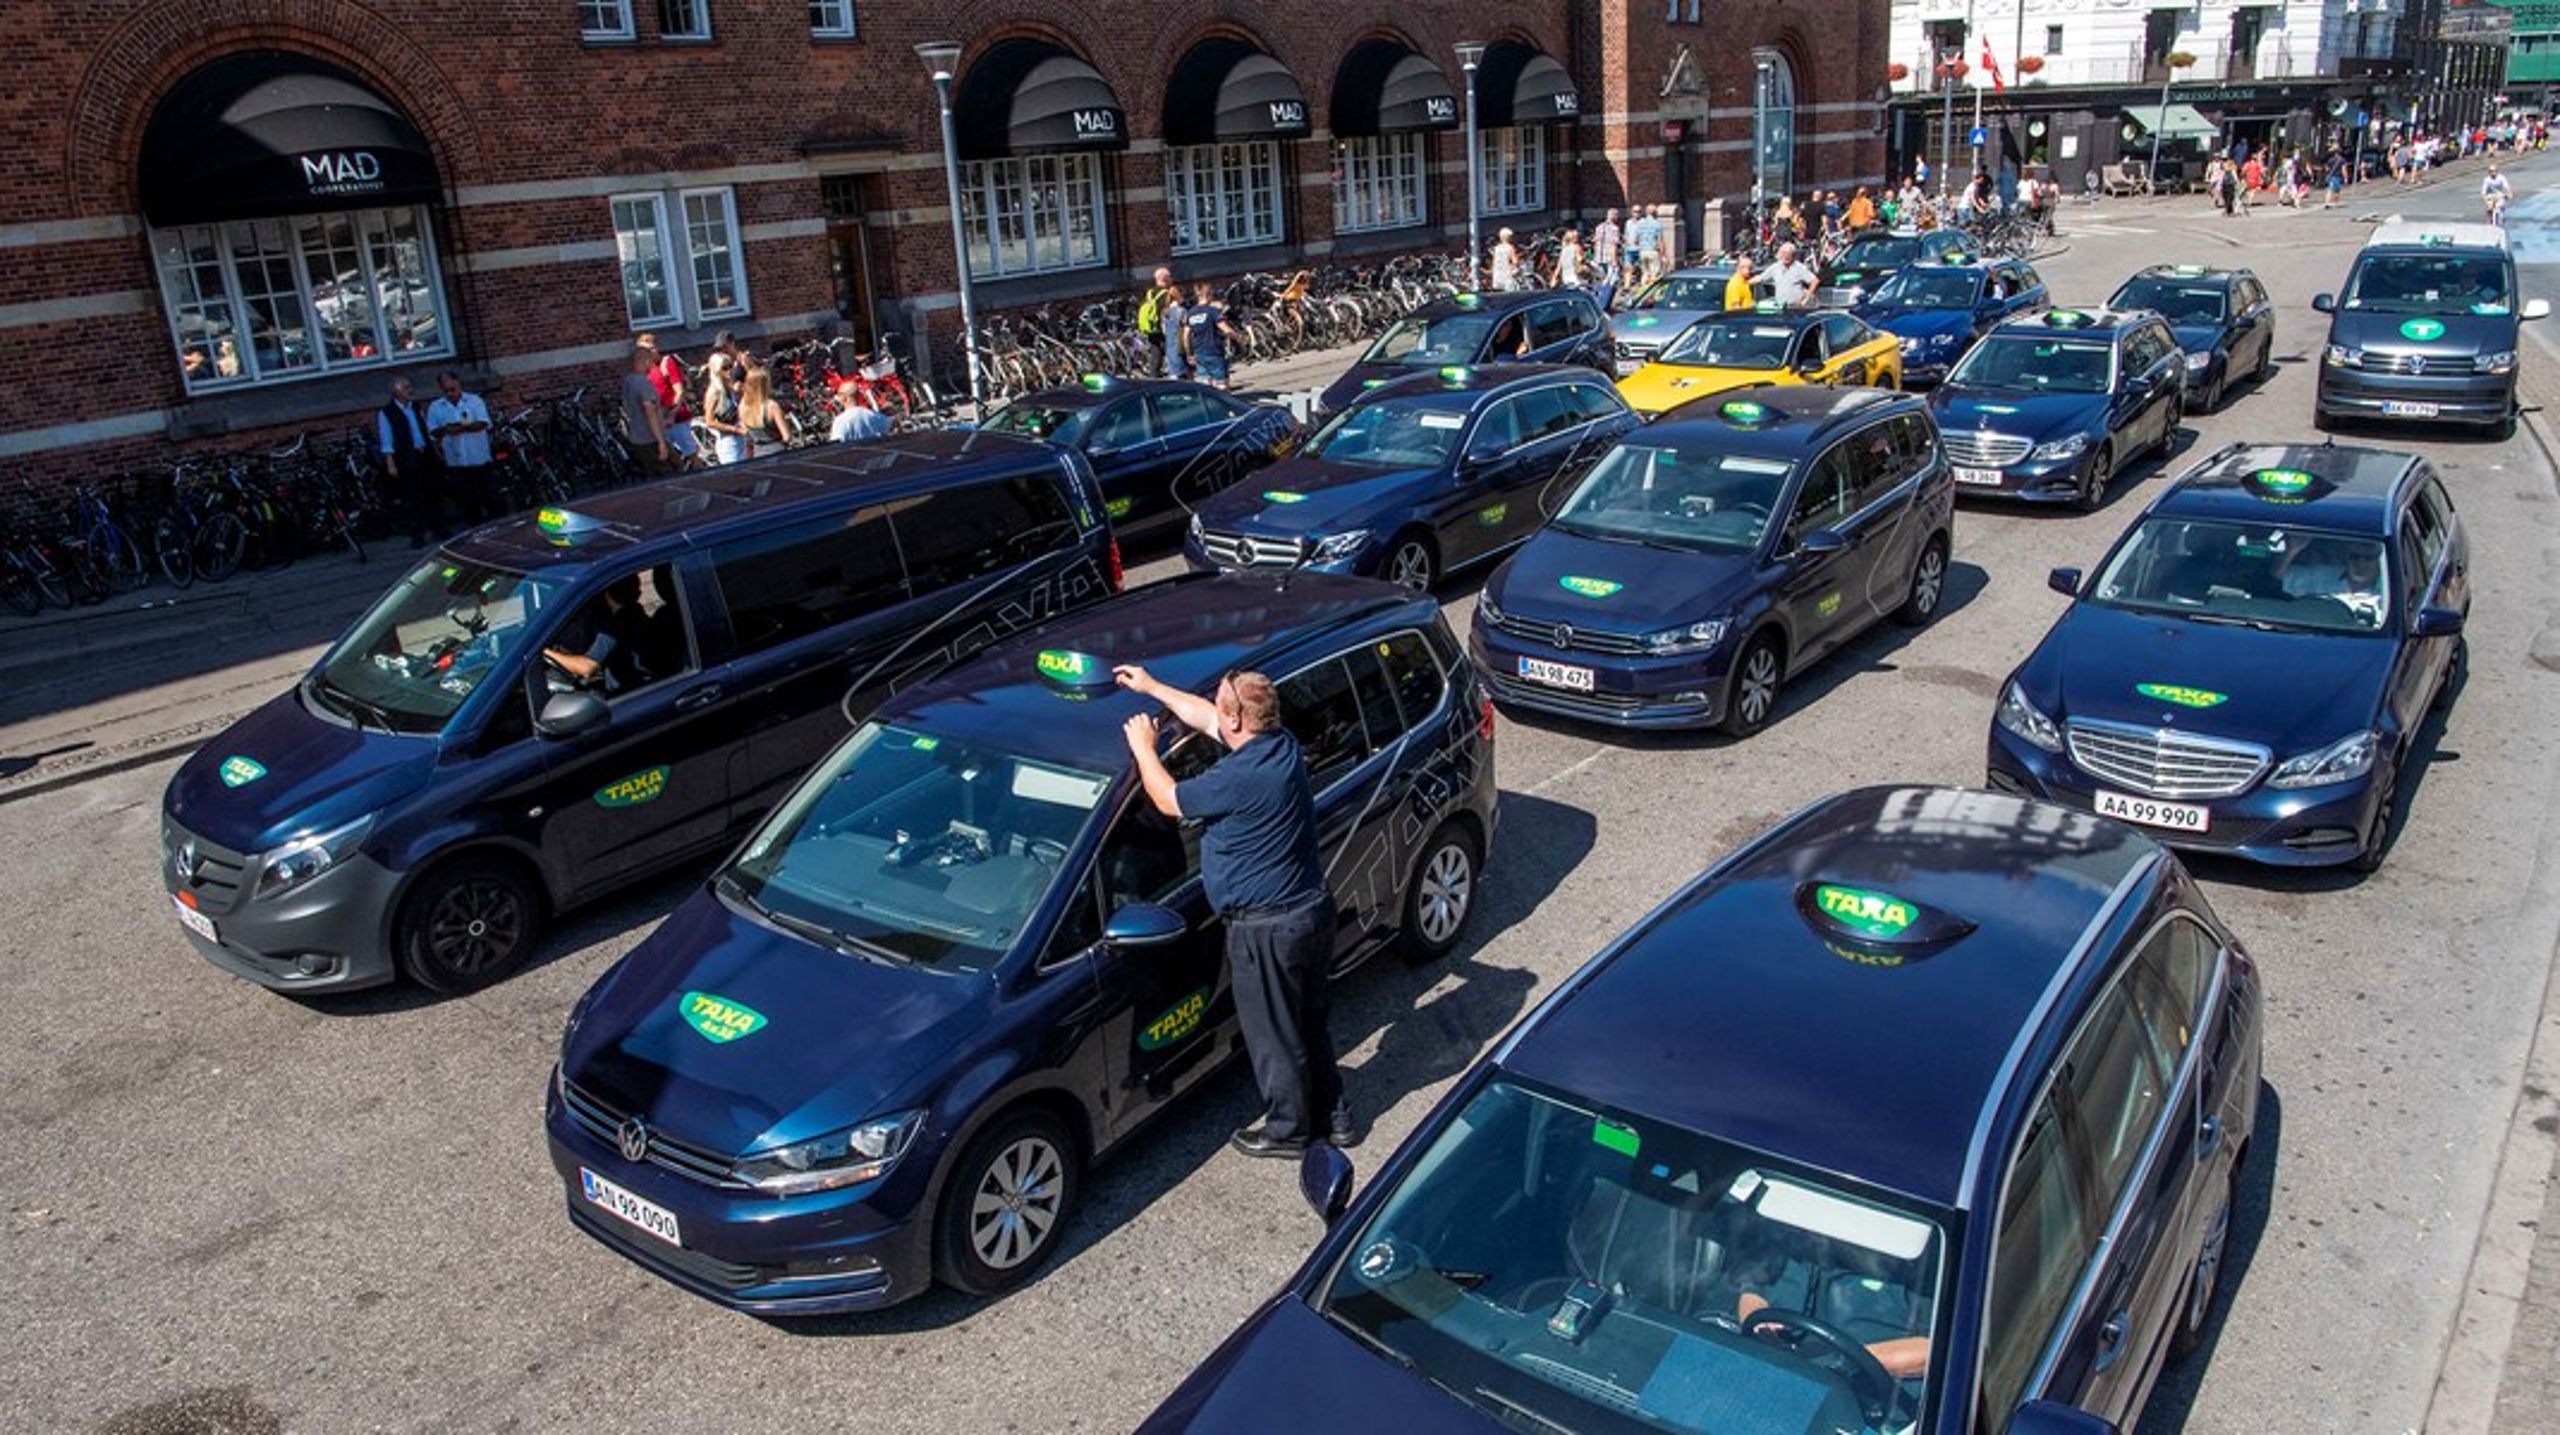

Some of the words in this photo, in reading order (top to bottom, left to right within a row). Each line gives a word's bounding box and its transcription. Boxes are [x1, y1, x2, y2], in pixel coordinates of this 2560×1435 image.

[1271, 102, 1303, 122] MAD
[1428, 98, 1454, 116] MAD
[1073, 110, 1114, 132] MAD
[301, 152, 380, 184] MAD
[2408, 324, 2439, 337] T
[2261, 470, 2309, 486] TAXA
[1038, 652, 1083, 675] TAXA
[1547, 665, 1564, 682] 98
[2148, 683, 2218, 703] TAXA
[603, 769, 664, 801] TAXA
[2103, 796, 2129, 816] AA
[2133, 802, 2158, 821] 99
[2161, 807, 2200, 826] 990
[1823, 888, 1908, 928] TAXA
[691, 996, 755, 1032] TAXA
[1147, 993, 1204, 1041] TAXA
[595, 1181, 616, 1209] AN
[619, 1193, 639, 1222] 98
[643, 1205, 676, 1239] 090
